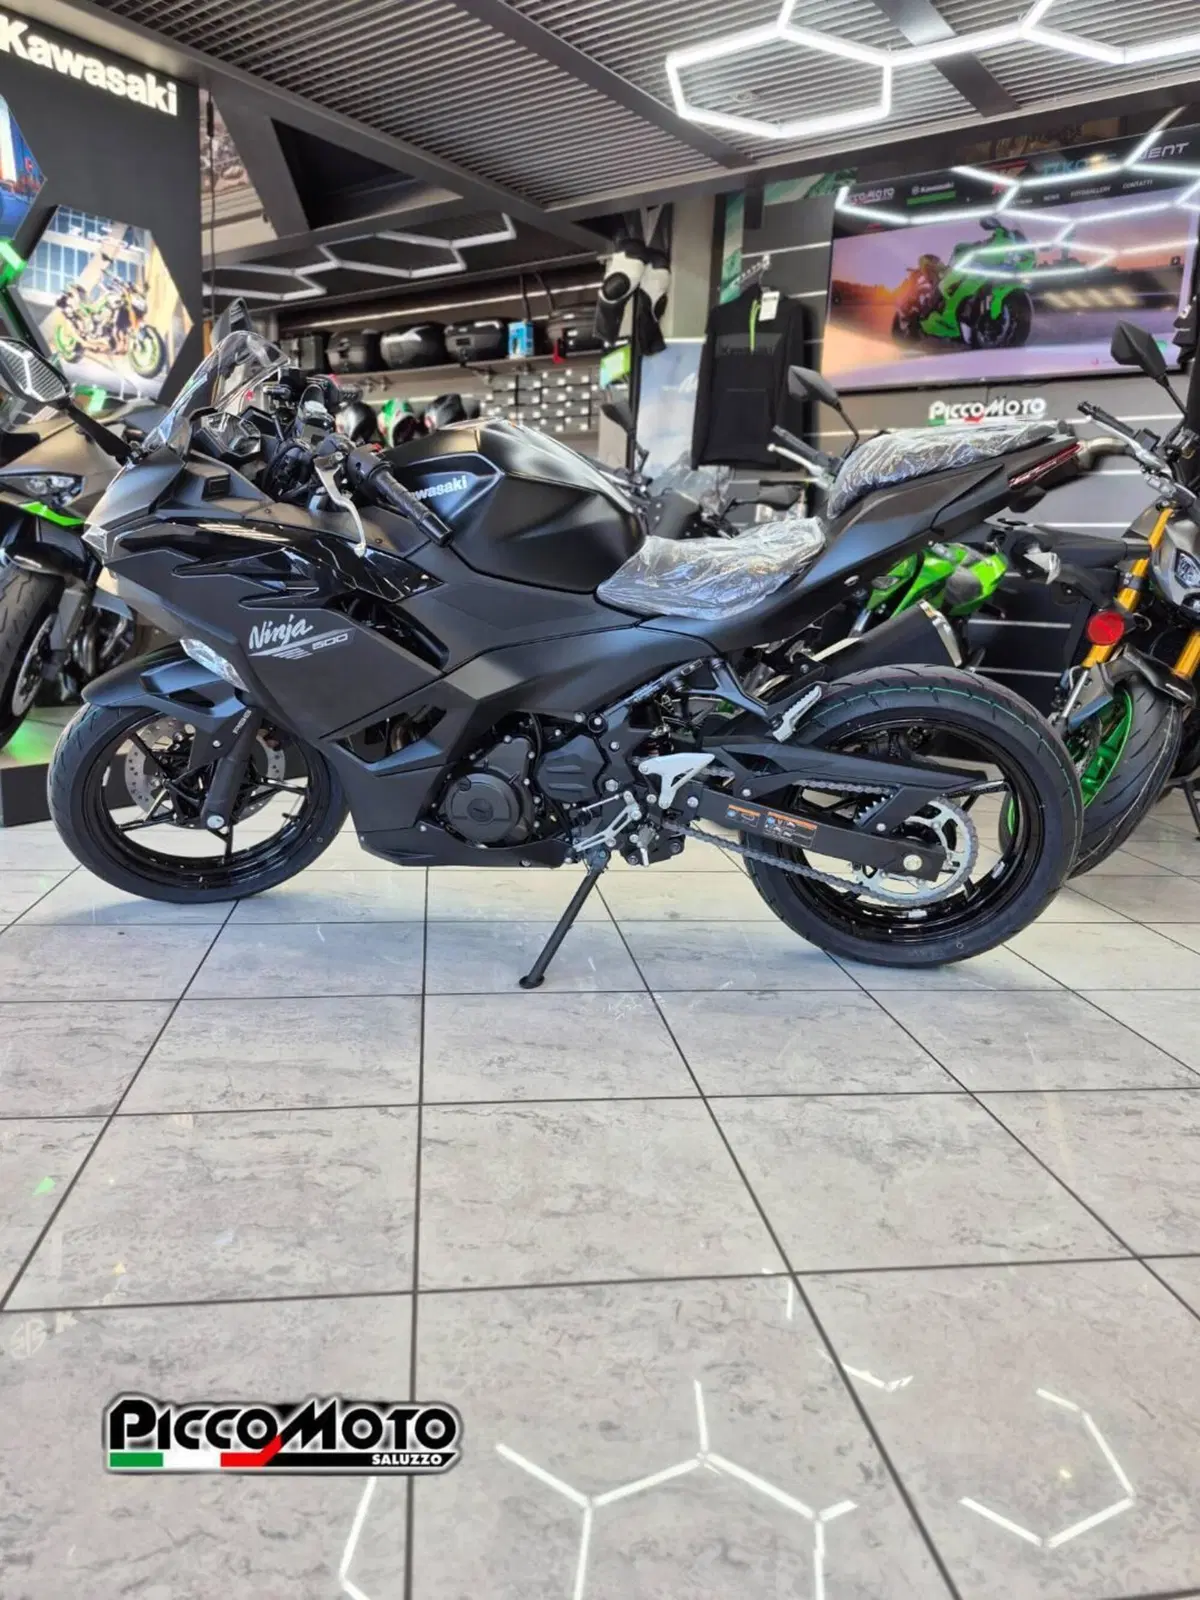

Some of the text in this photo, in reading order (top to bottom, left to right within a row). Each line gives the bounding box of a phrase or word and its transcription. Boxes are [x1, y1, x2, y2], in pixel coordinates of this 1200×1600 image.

[0, 14, 177, 116] Kawasaki
[411, 474, 467, 501] wasaki
[248, 613, 314, 649] Ninja
